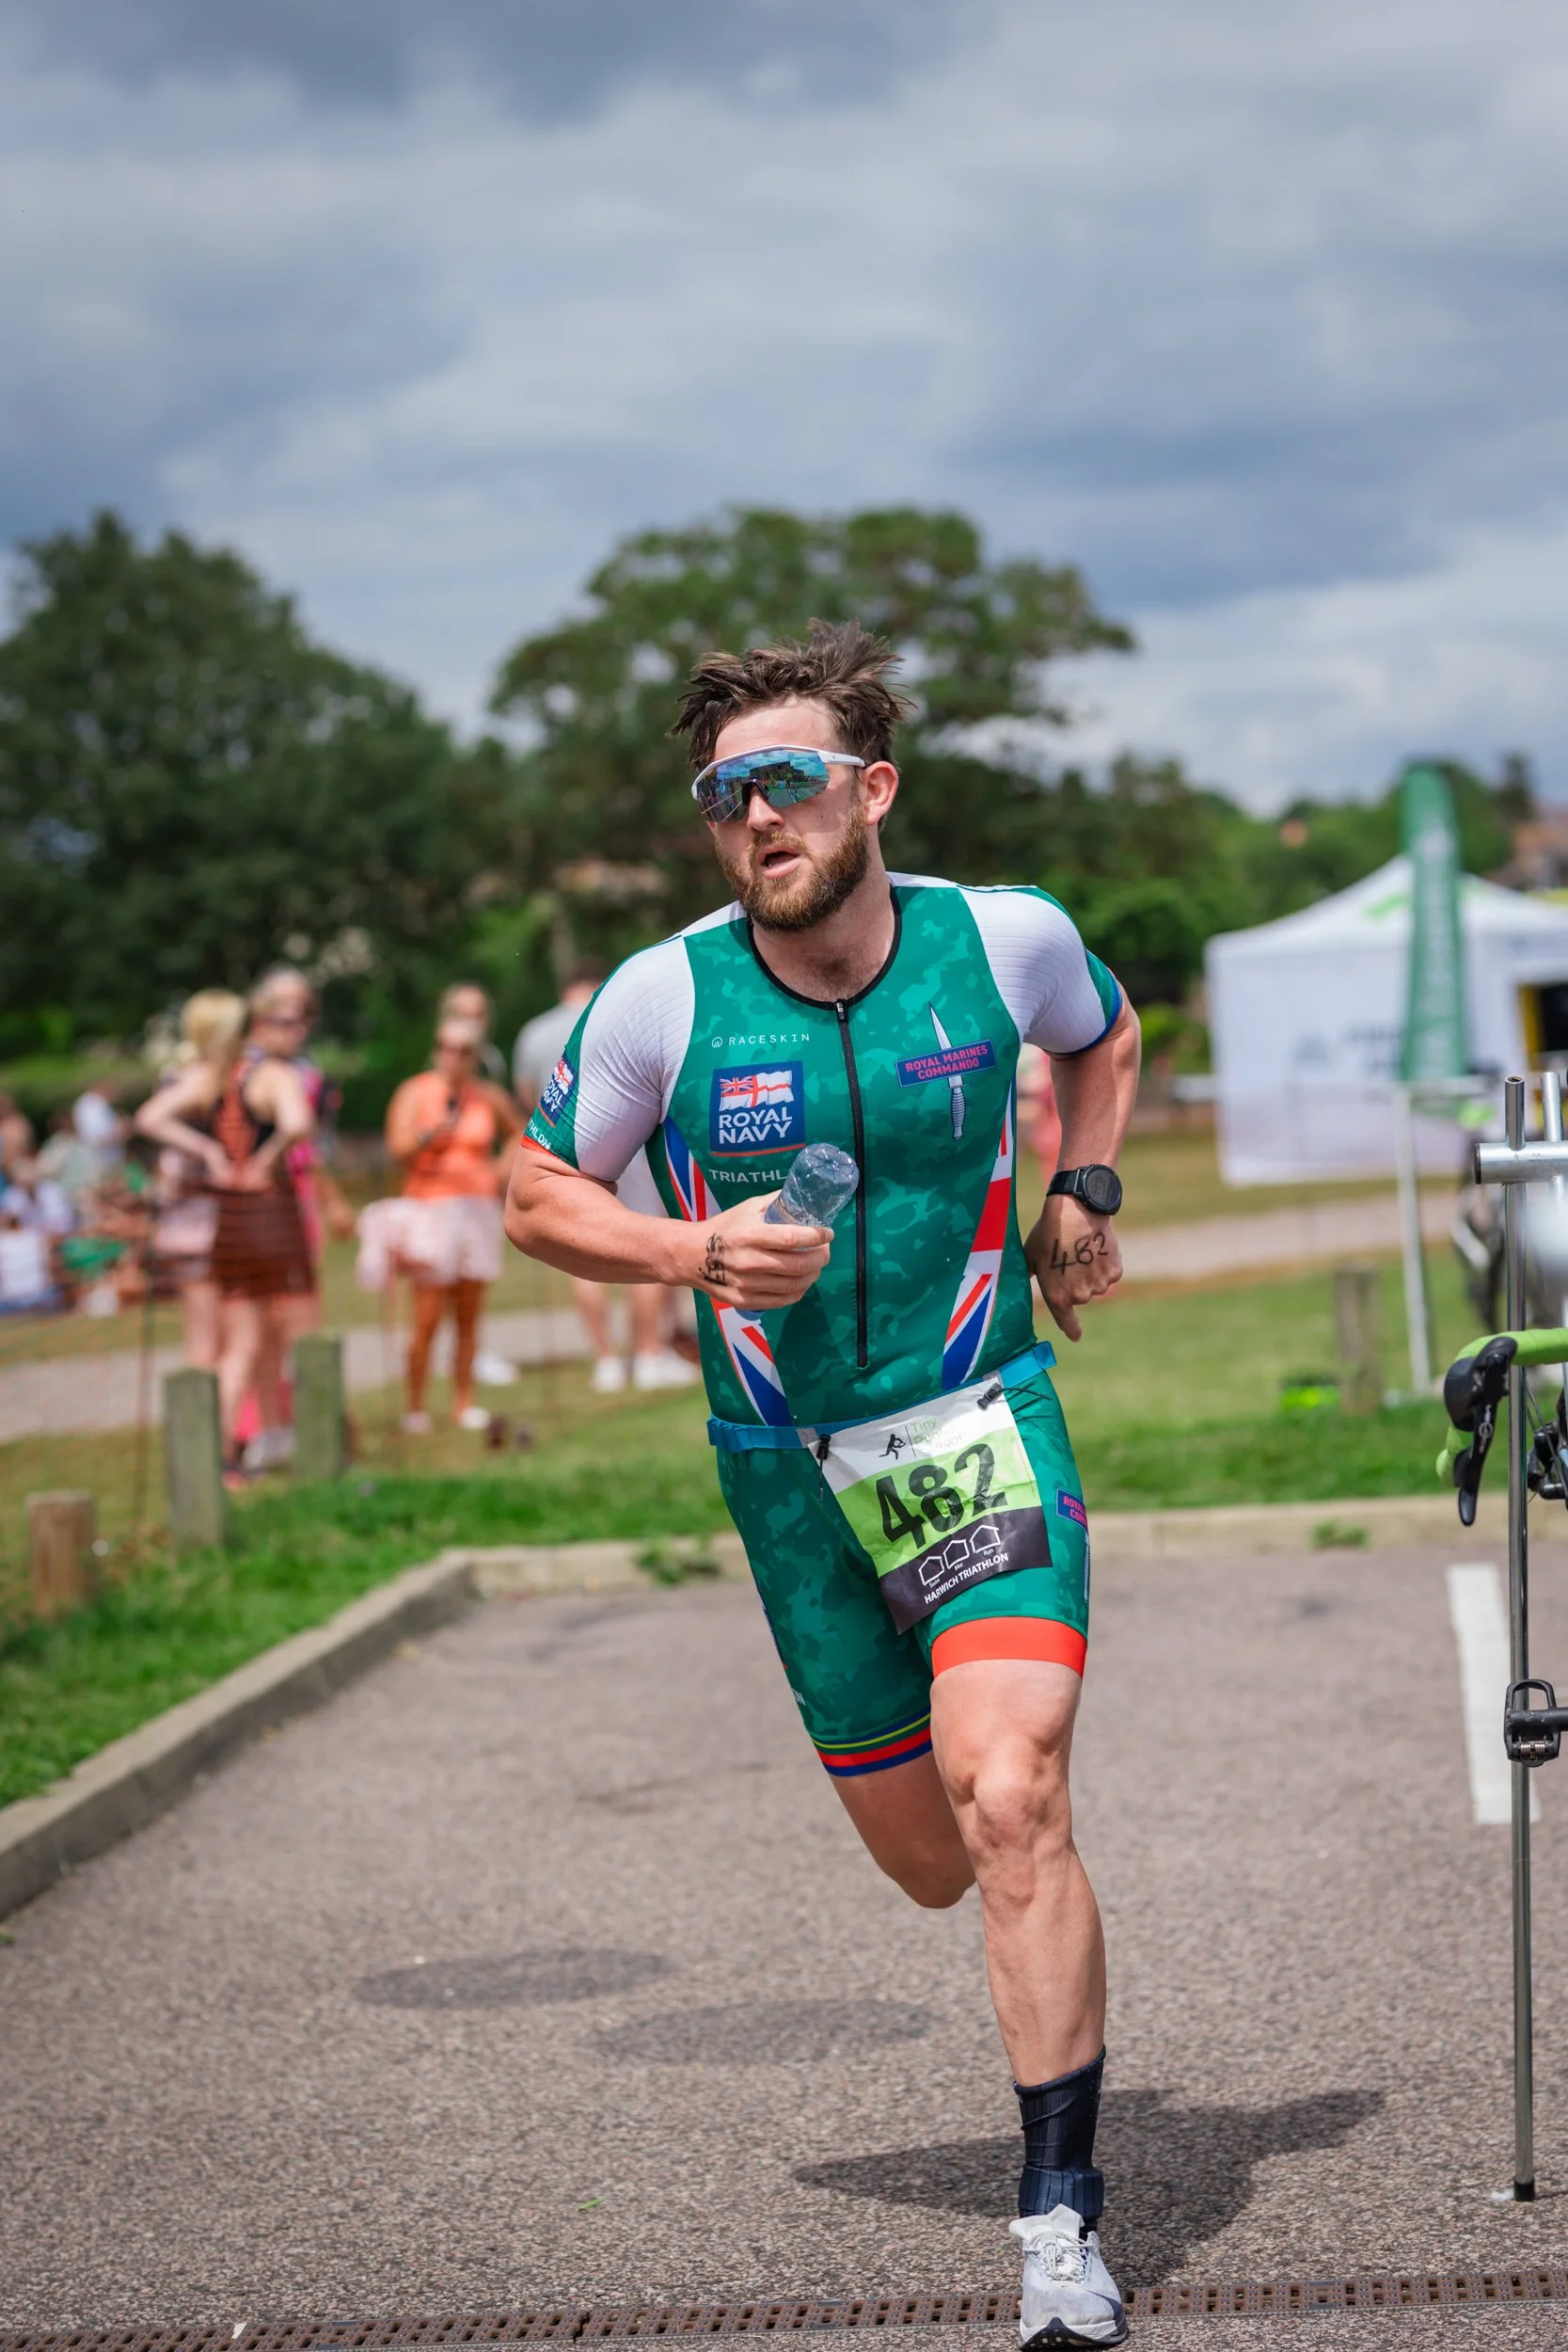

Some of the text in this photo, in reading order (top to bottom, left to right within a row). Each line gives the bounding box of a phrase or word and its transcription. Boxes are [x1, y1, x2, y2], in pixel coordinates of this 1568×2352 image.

[728, 1033, 810, 1046] RACESKIN
[905, 1045, 988, 1073] ROYAL MARINES
[918, 1058, 979, 1080] COMMANDO
[546, 1079, 562, 1105] OYAL
[719, 1106, 793, 1129] ROYAL
[719, 1120, 793, 1144] NAVY
[709, 1168, 786, 1184] TRIATHL
[1049, 1232, 1109, 1276] 482
[875, 1443, 1008, 1549] 482
[924, 1552, 1009, 1604] HARWICH TRIATHLON
